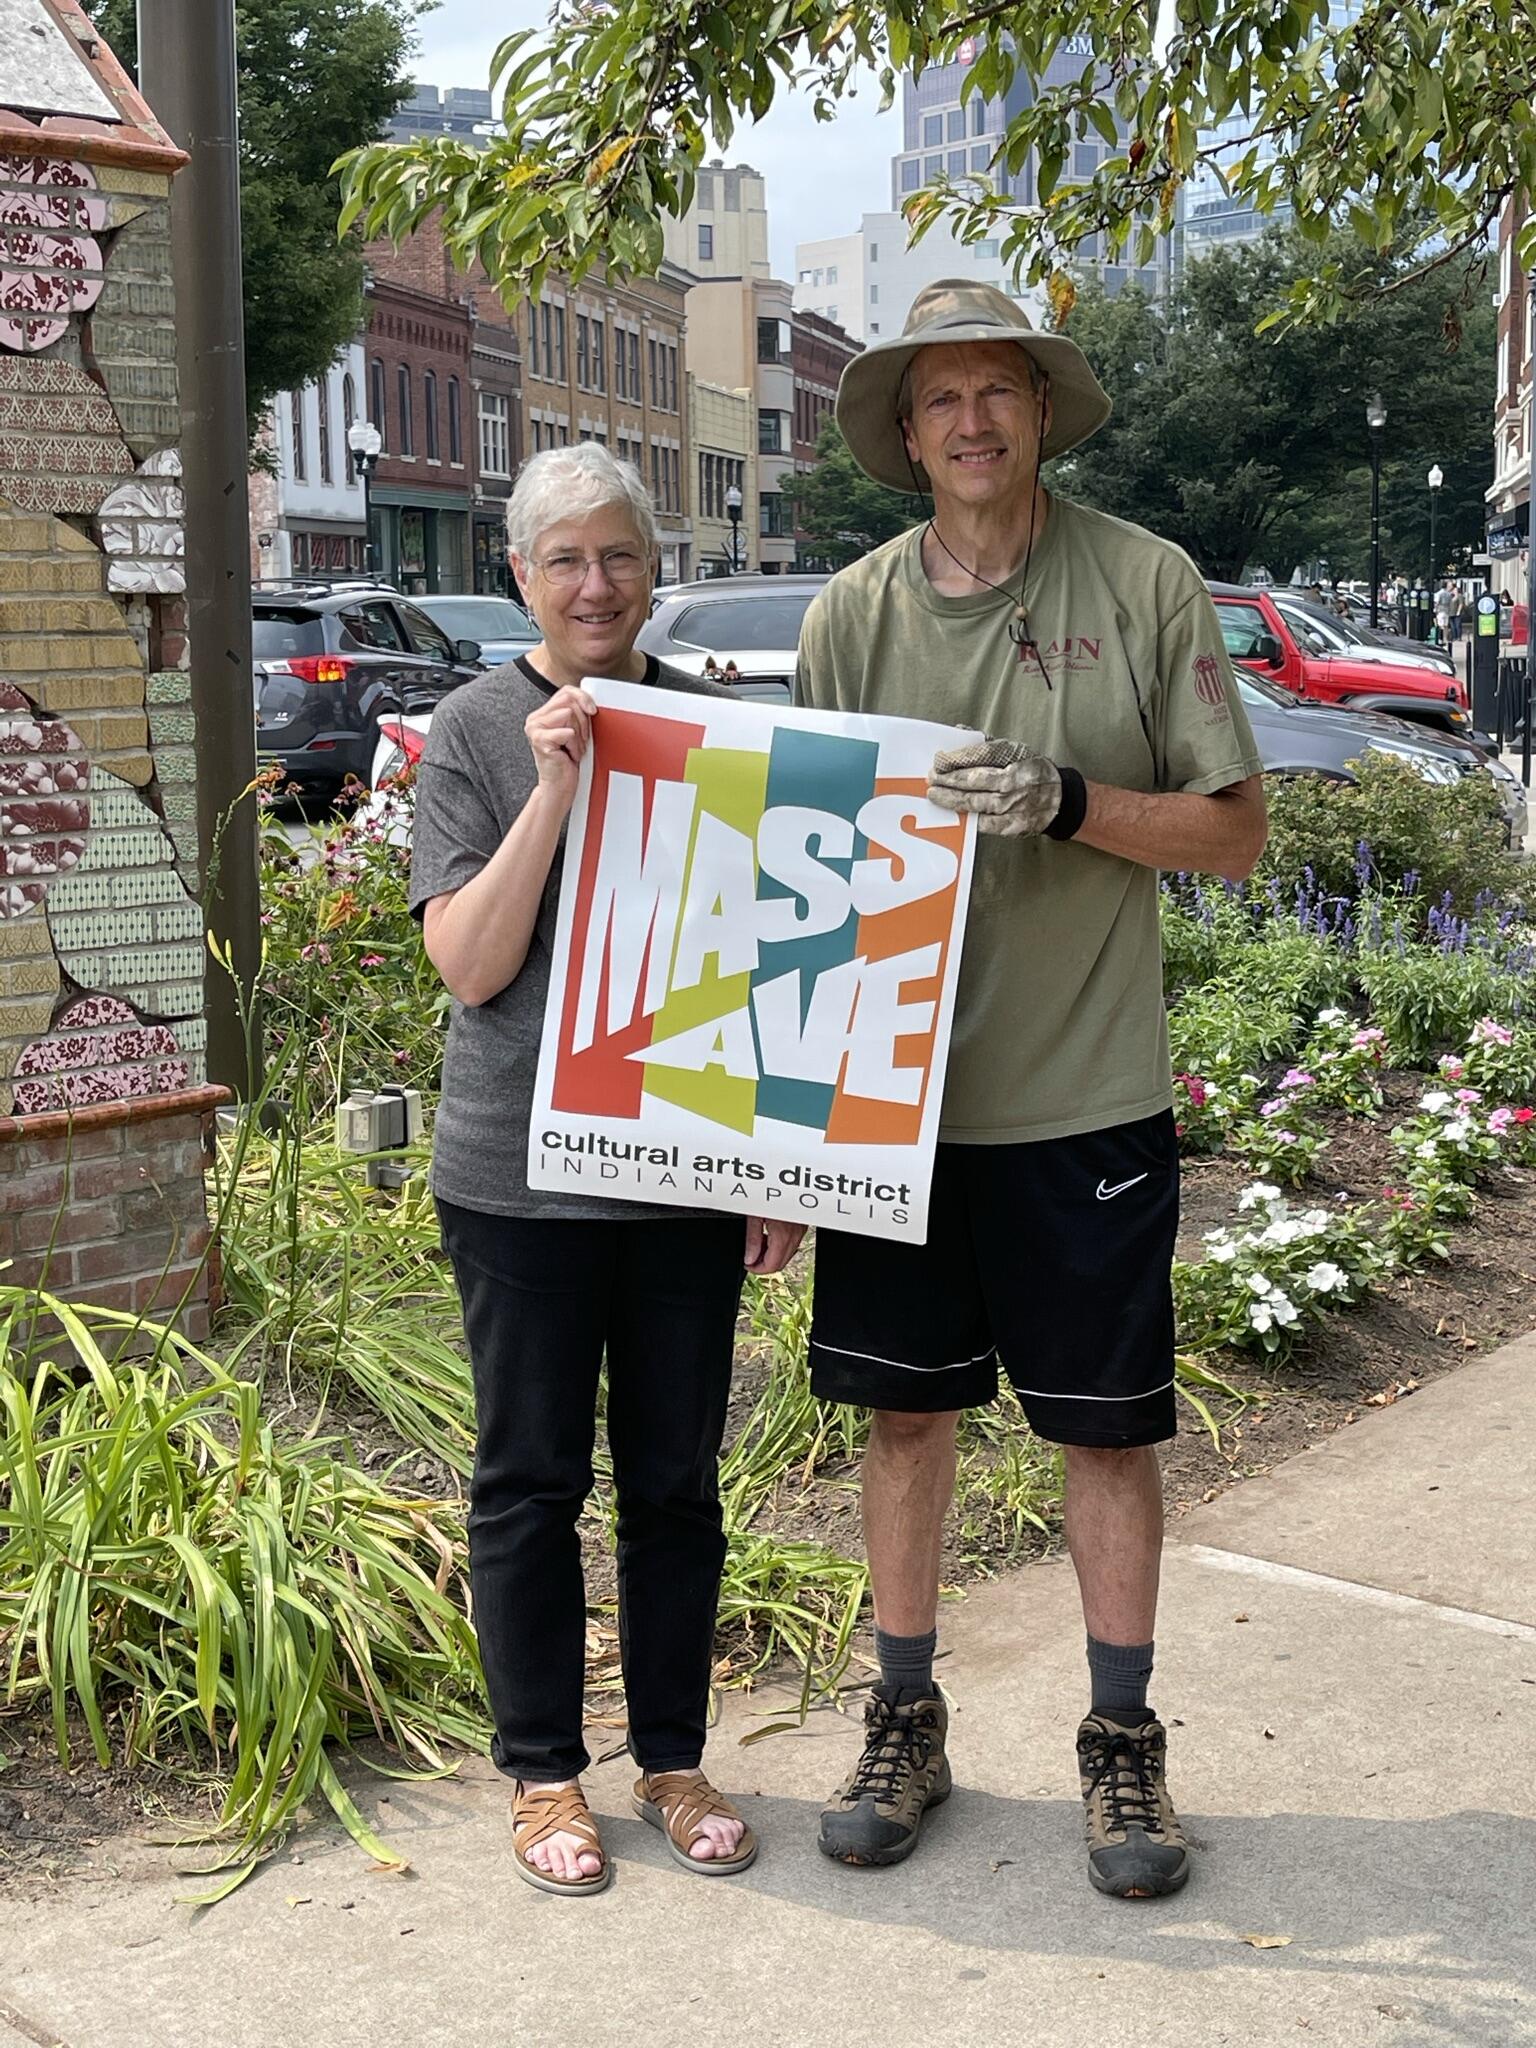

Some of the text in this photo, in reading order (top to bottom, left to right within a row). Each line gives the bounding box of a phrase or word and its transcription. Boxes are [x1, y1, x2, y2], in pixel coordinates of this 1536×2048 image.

[1064, 34, 1096, 57] BM
[571, 770, 960, 1056] MASS
[623, 942, 942, 1107] AVE
[540, 1153, 910, 1226] INDIANAPOLIS
[541, 1130, 911, 1205] cultural arts district
